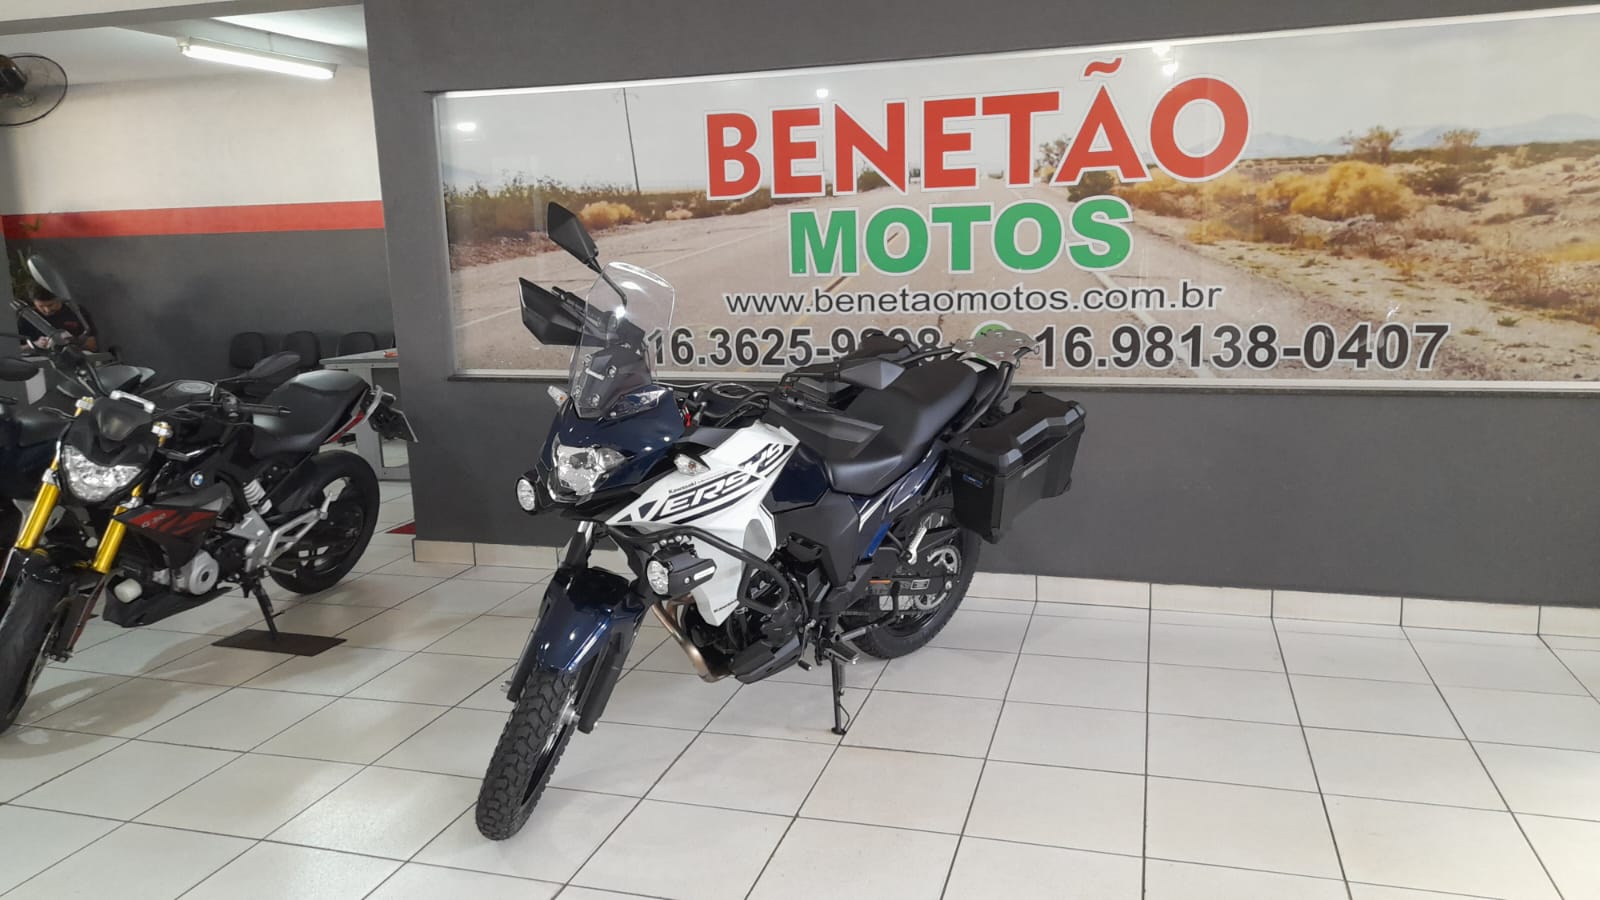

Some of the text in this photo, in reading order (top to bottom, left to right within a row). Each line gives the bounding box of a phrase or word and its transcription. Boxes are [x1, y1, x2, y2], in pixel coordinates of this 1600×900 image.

[706, 57, 1249, 199] BENETÃO
[790, 198, 1132, 274] MOTOS
[726, 281, 1223, 313] www.benetaomotos.com.br
[647, 324, 1449, 369] 16.3625-98 16.98138-0407
